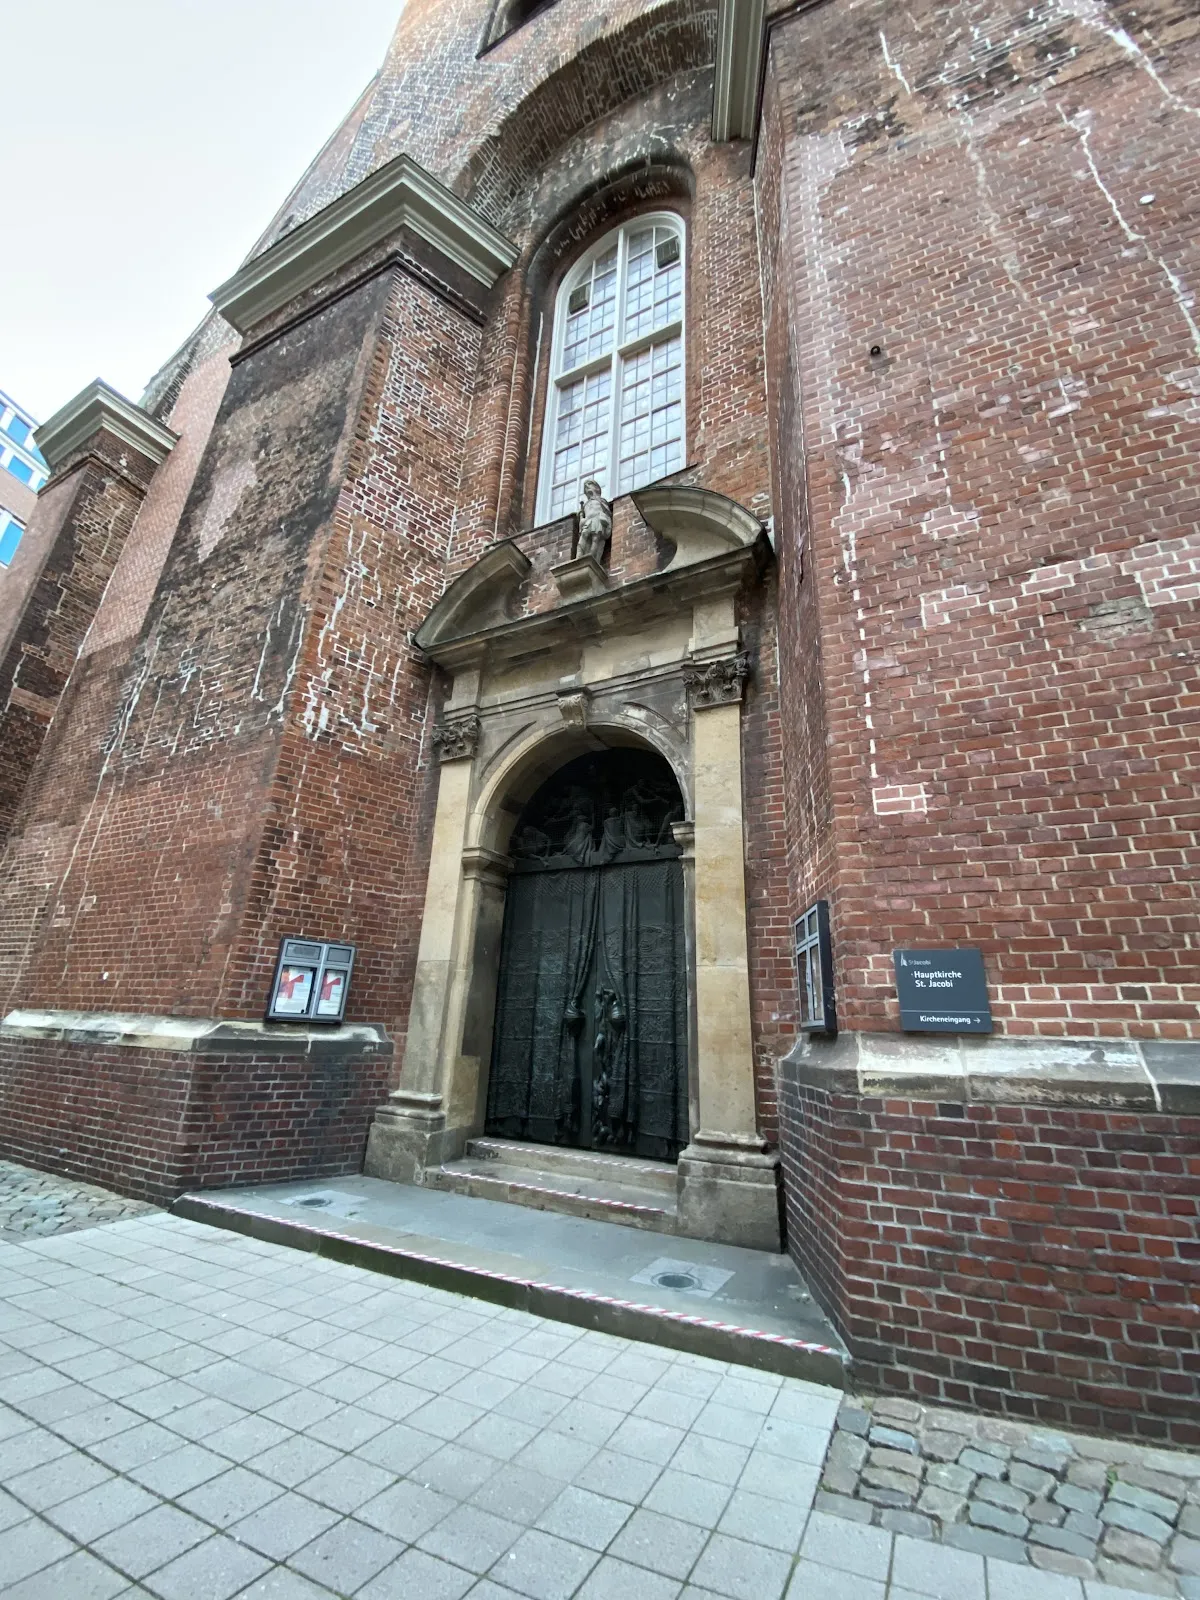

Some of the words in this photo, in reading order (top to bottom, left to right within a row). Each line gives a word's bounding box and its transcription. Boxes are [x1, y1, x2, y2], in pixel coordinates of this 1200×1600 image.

[914, 971, 962, 979] Hauptkirche
[915, 980, 926, 988] St.
[928, 980, 953, 988] Jacobi
[919, 1016, 971, 1024] Kircheneingang
